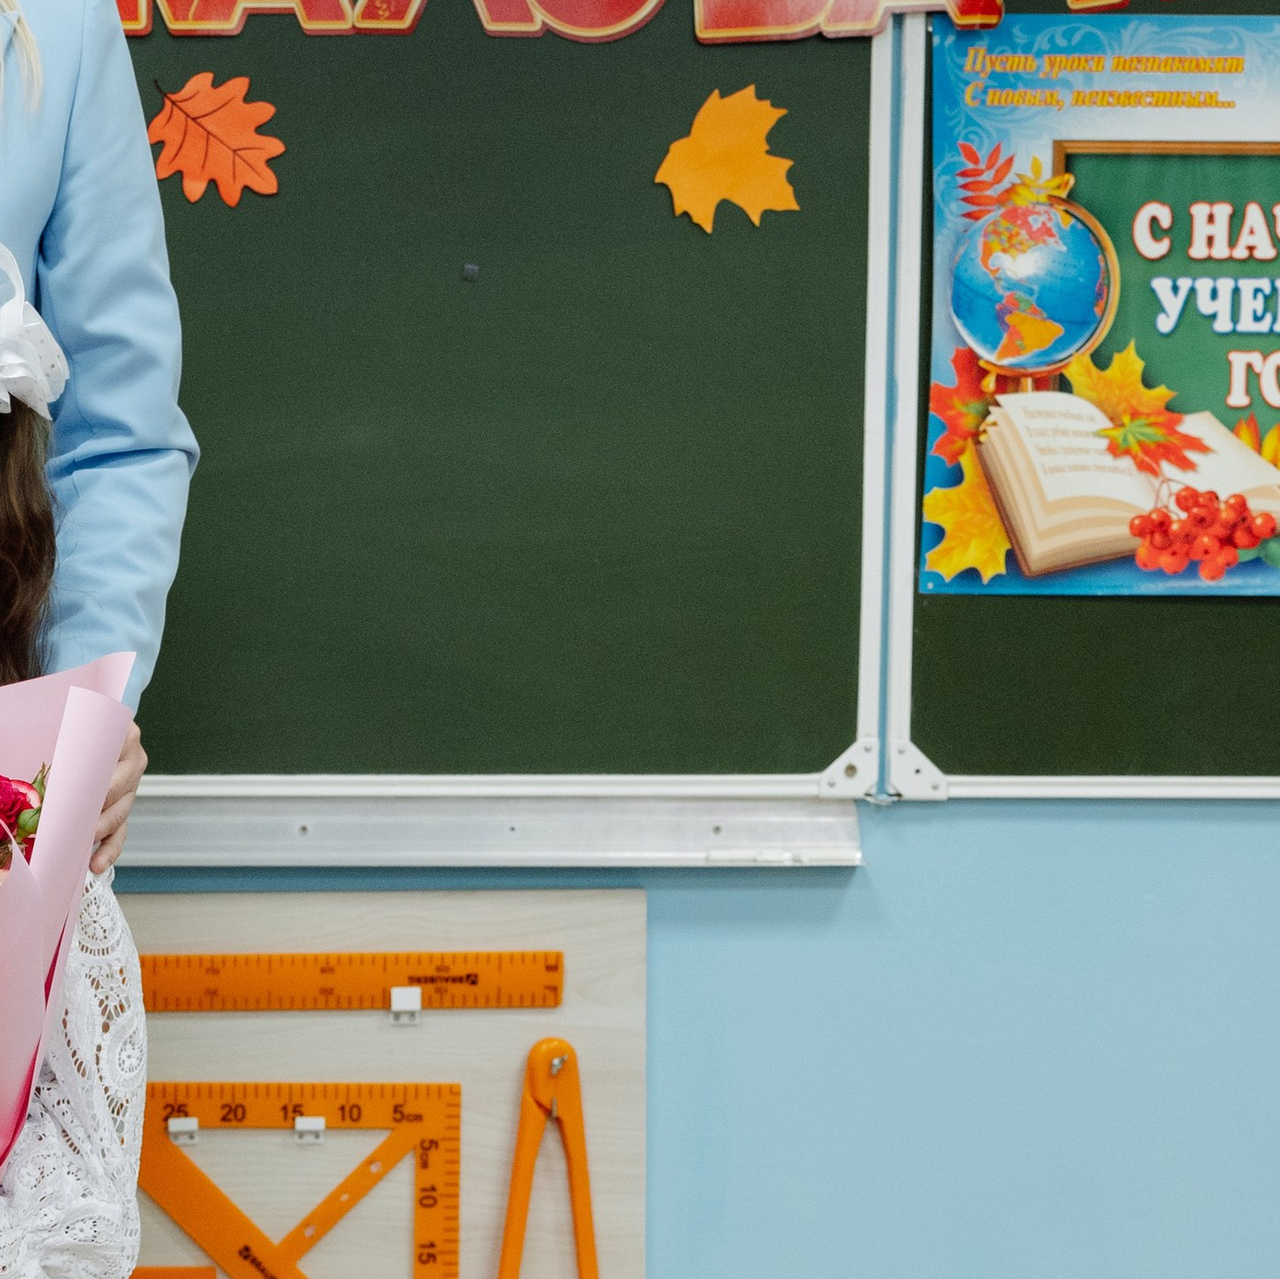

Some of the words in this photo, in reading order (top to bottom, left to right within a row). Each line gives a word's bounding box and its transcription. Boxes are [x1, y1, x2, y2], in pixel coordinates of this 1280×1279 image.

[963, 46, 1037, 75] Пусть
[1040, 54, 1106, 79] уроки
[1110, 55, 1246, 74] познакомят
[963, 81, 984, 107] С
[985, 88, 1065, 111] новым,
[1132, 200, 1173, 260] С
[1187, 200, 1280, 260] НА
[1150, 276, 1280, 336] УЧЕ
[220, 1103, 247, 1123] 20
[280, 1103, 305, 1122] 15
[338, 1103, 363, 1123] 10
[392, 1103, 424, 1123] 5cm
[418, 1184, 439, 1209] 10
[417, 1241, 437, 1265] 15
